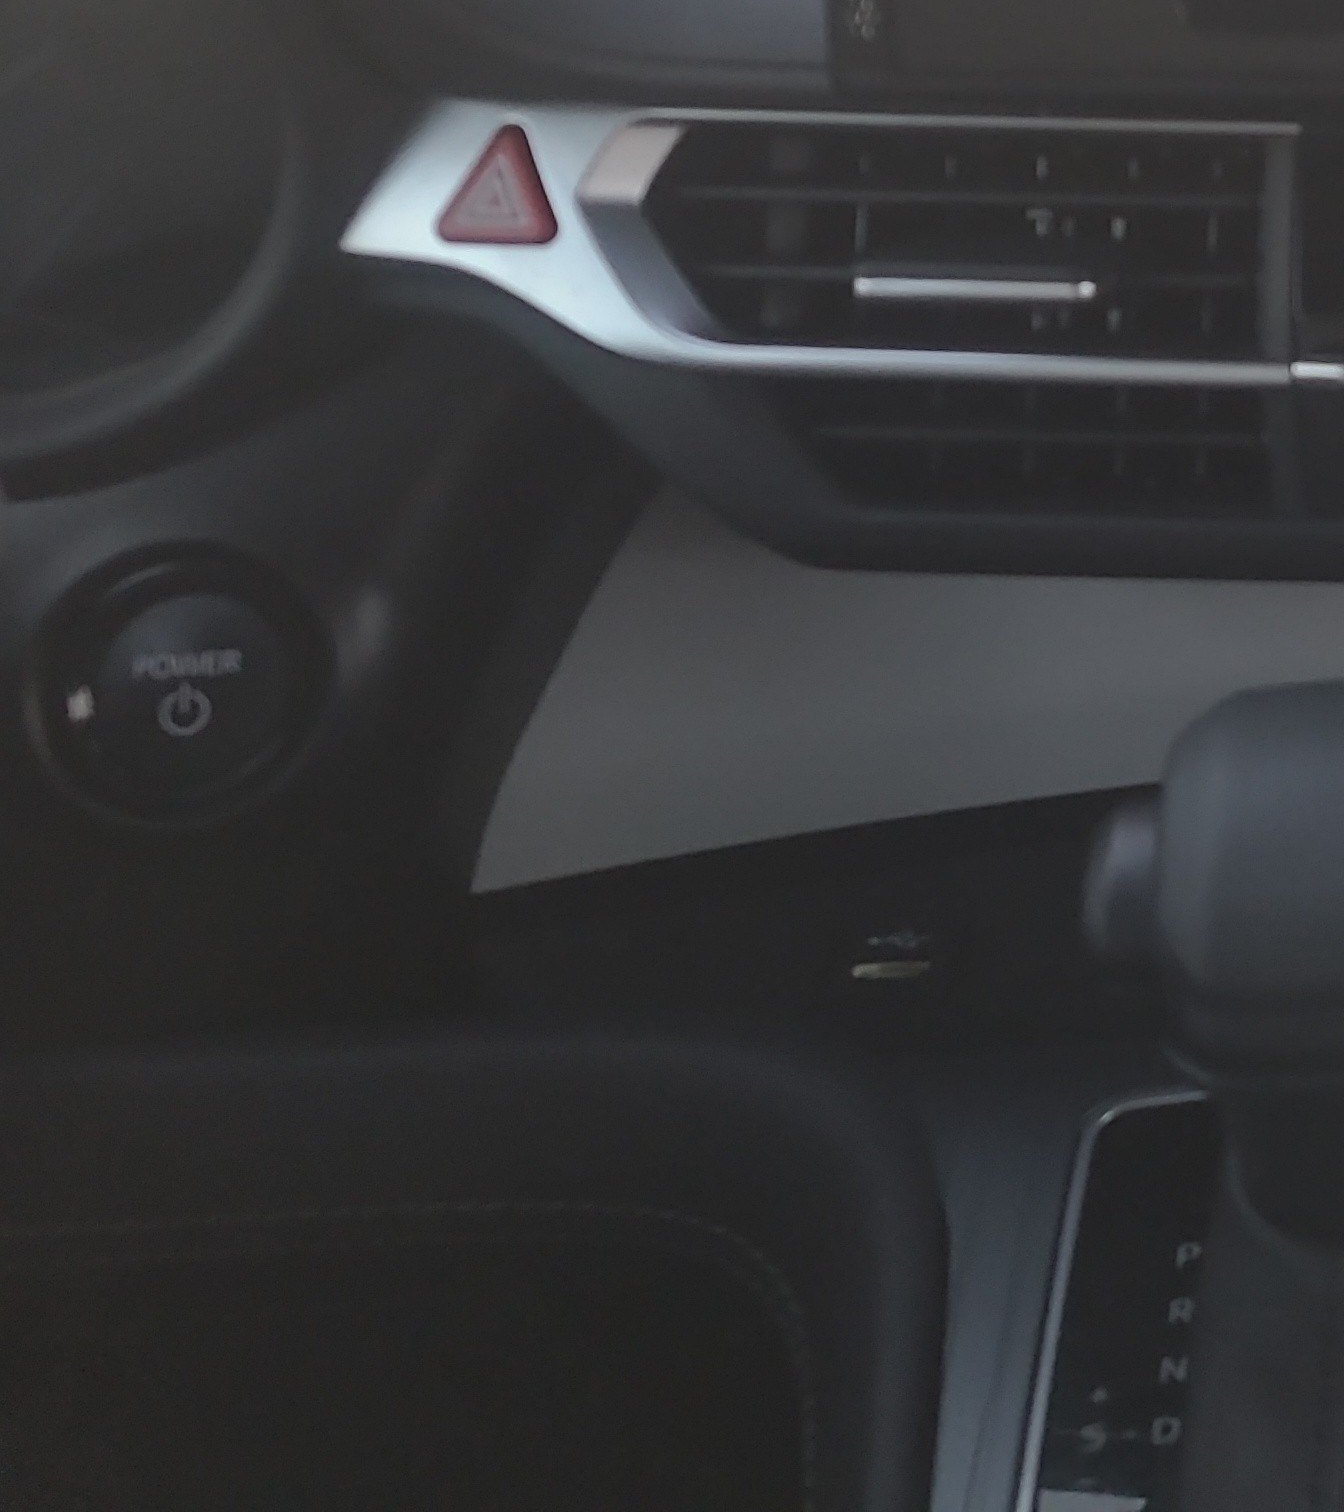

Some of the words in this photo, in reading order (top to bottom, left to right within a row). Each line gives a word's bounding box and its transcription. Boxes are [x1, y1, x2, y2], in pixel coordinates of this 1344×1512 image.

[131, 648, 243, 681] POWER
[1175, 1241, 1203, 1271] P
[1168, 1296, 1196, 1325] R
[1158, 1356, 1189, 1385] N
[1151, 1415, 1183, 1447] D
